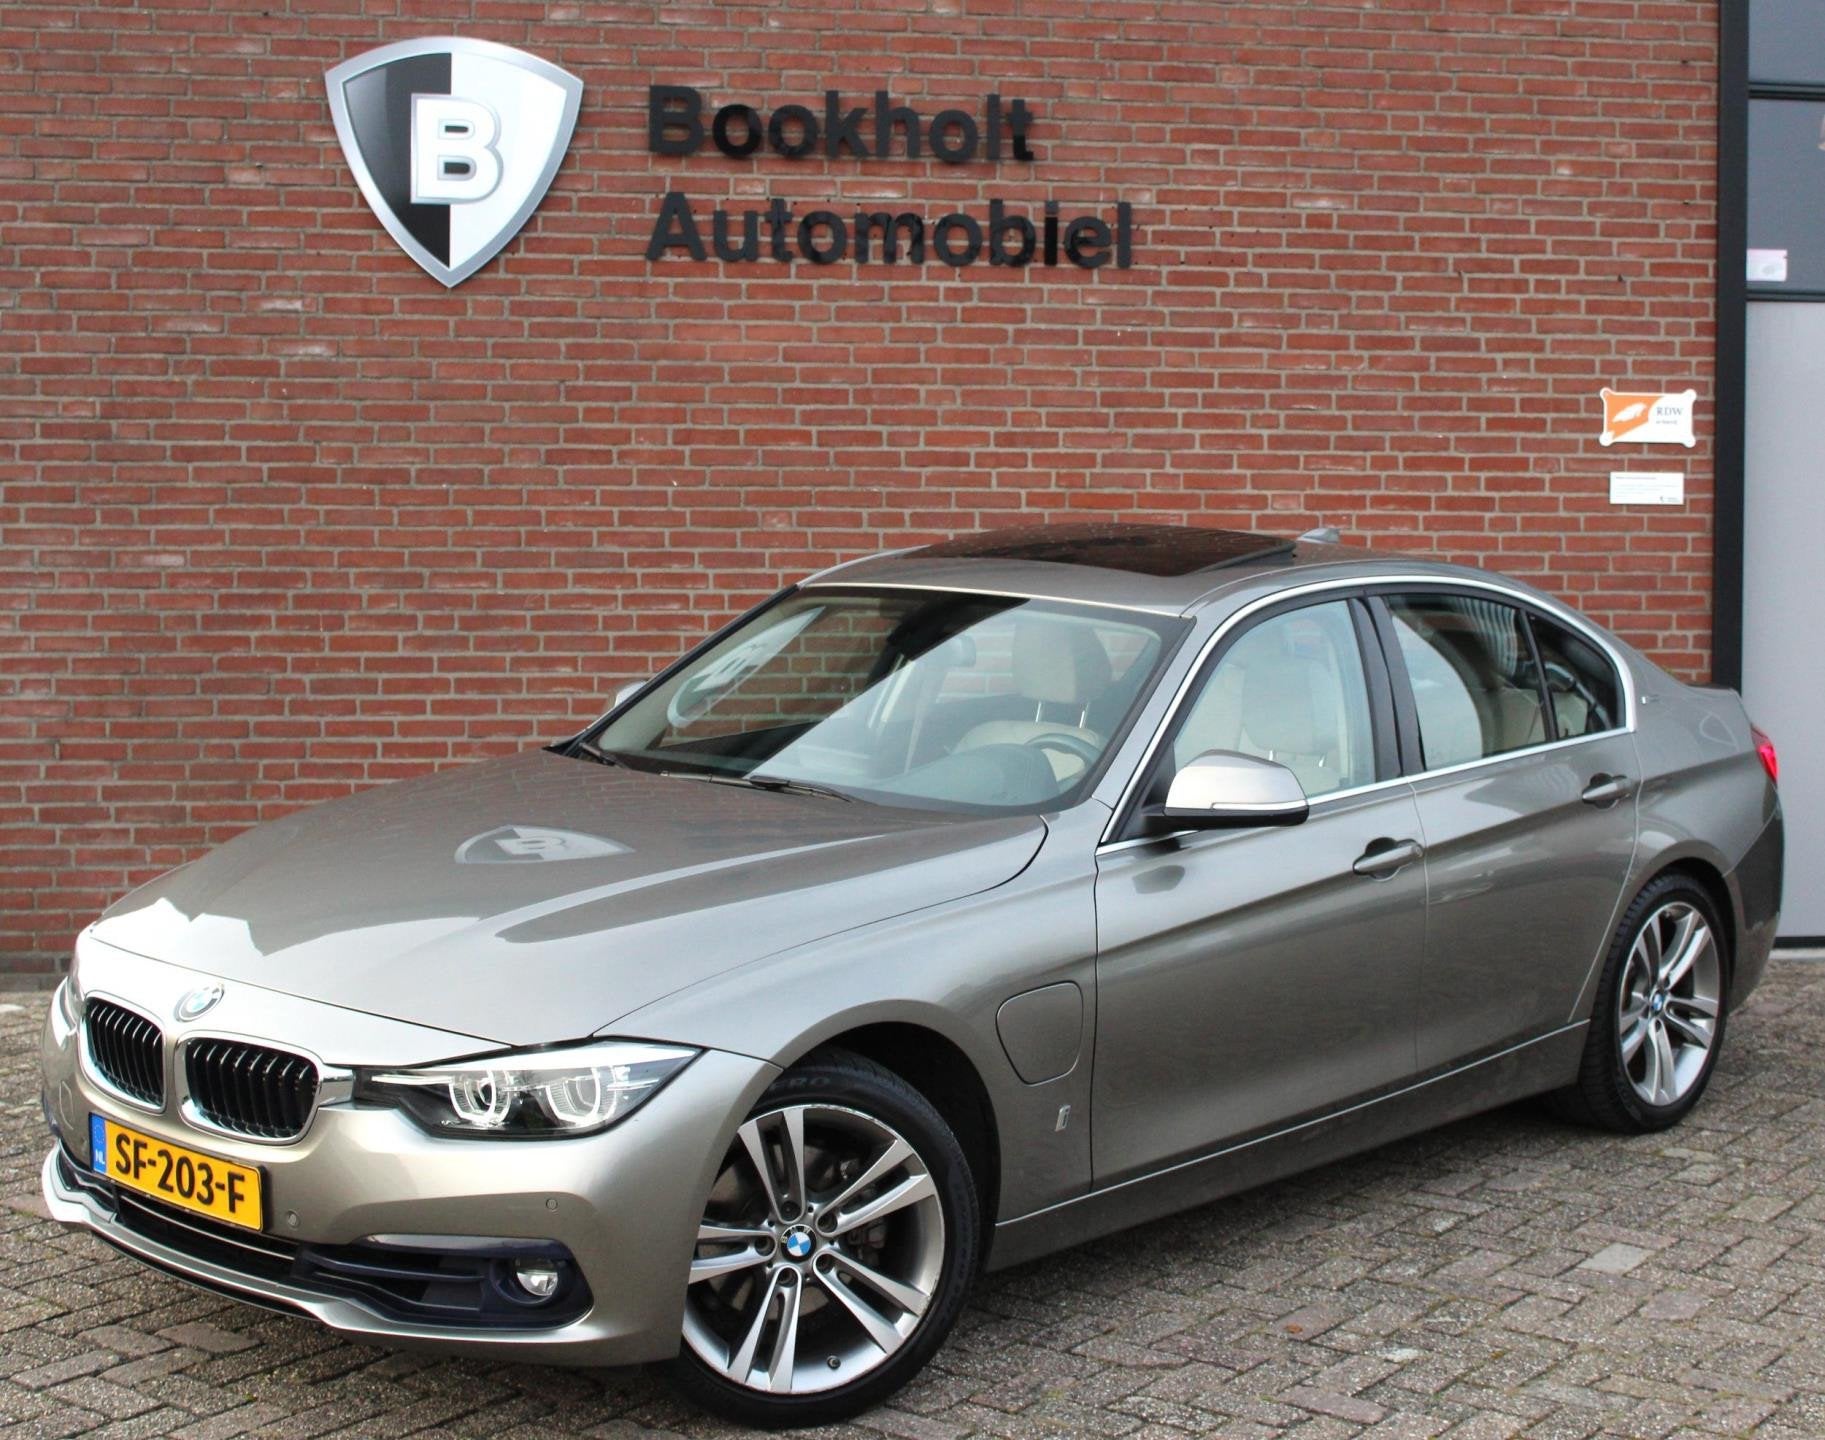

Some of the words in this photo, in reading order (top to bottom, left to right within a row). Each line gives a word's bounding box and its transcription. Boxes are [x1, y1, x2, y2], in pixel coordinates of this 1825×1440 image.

[410, 93, 503, 204] B
[650, 85, 1034, 164] Bookholt
[645, 192, 1132, 269] Automobiel
[1656, 407, 1684, 416] RDW
[95, 1149, 105, 1165] NL
[115, 1133, 245, 1213] SF-203-F
